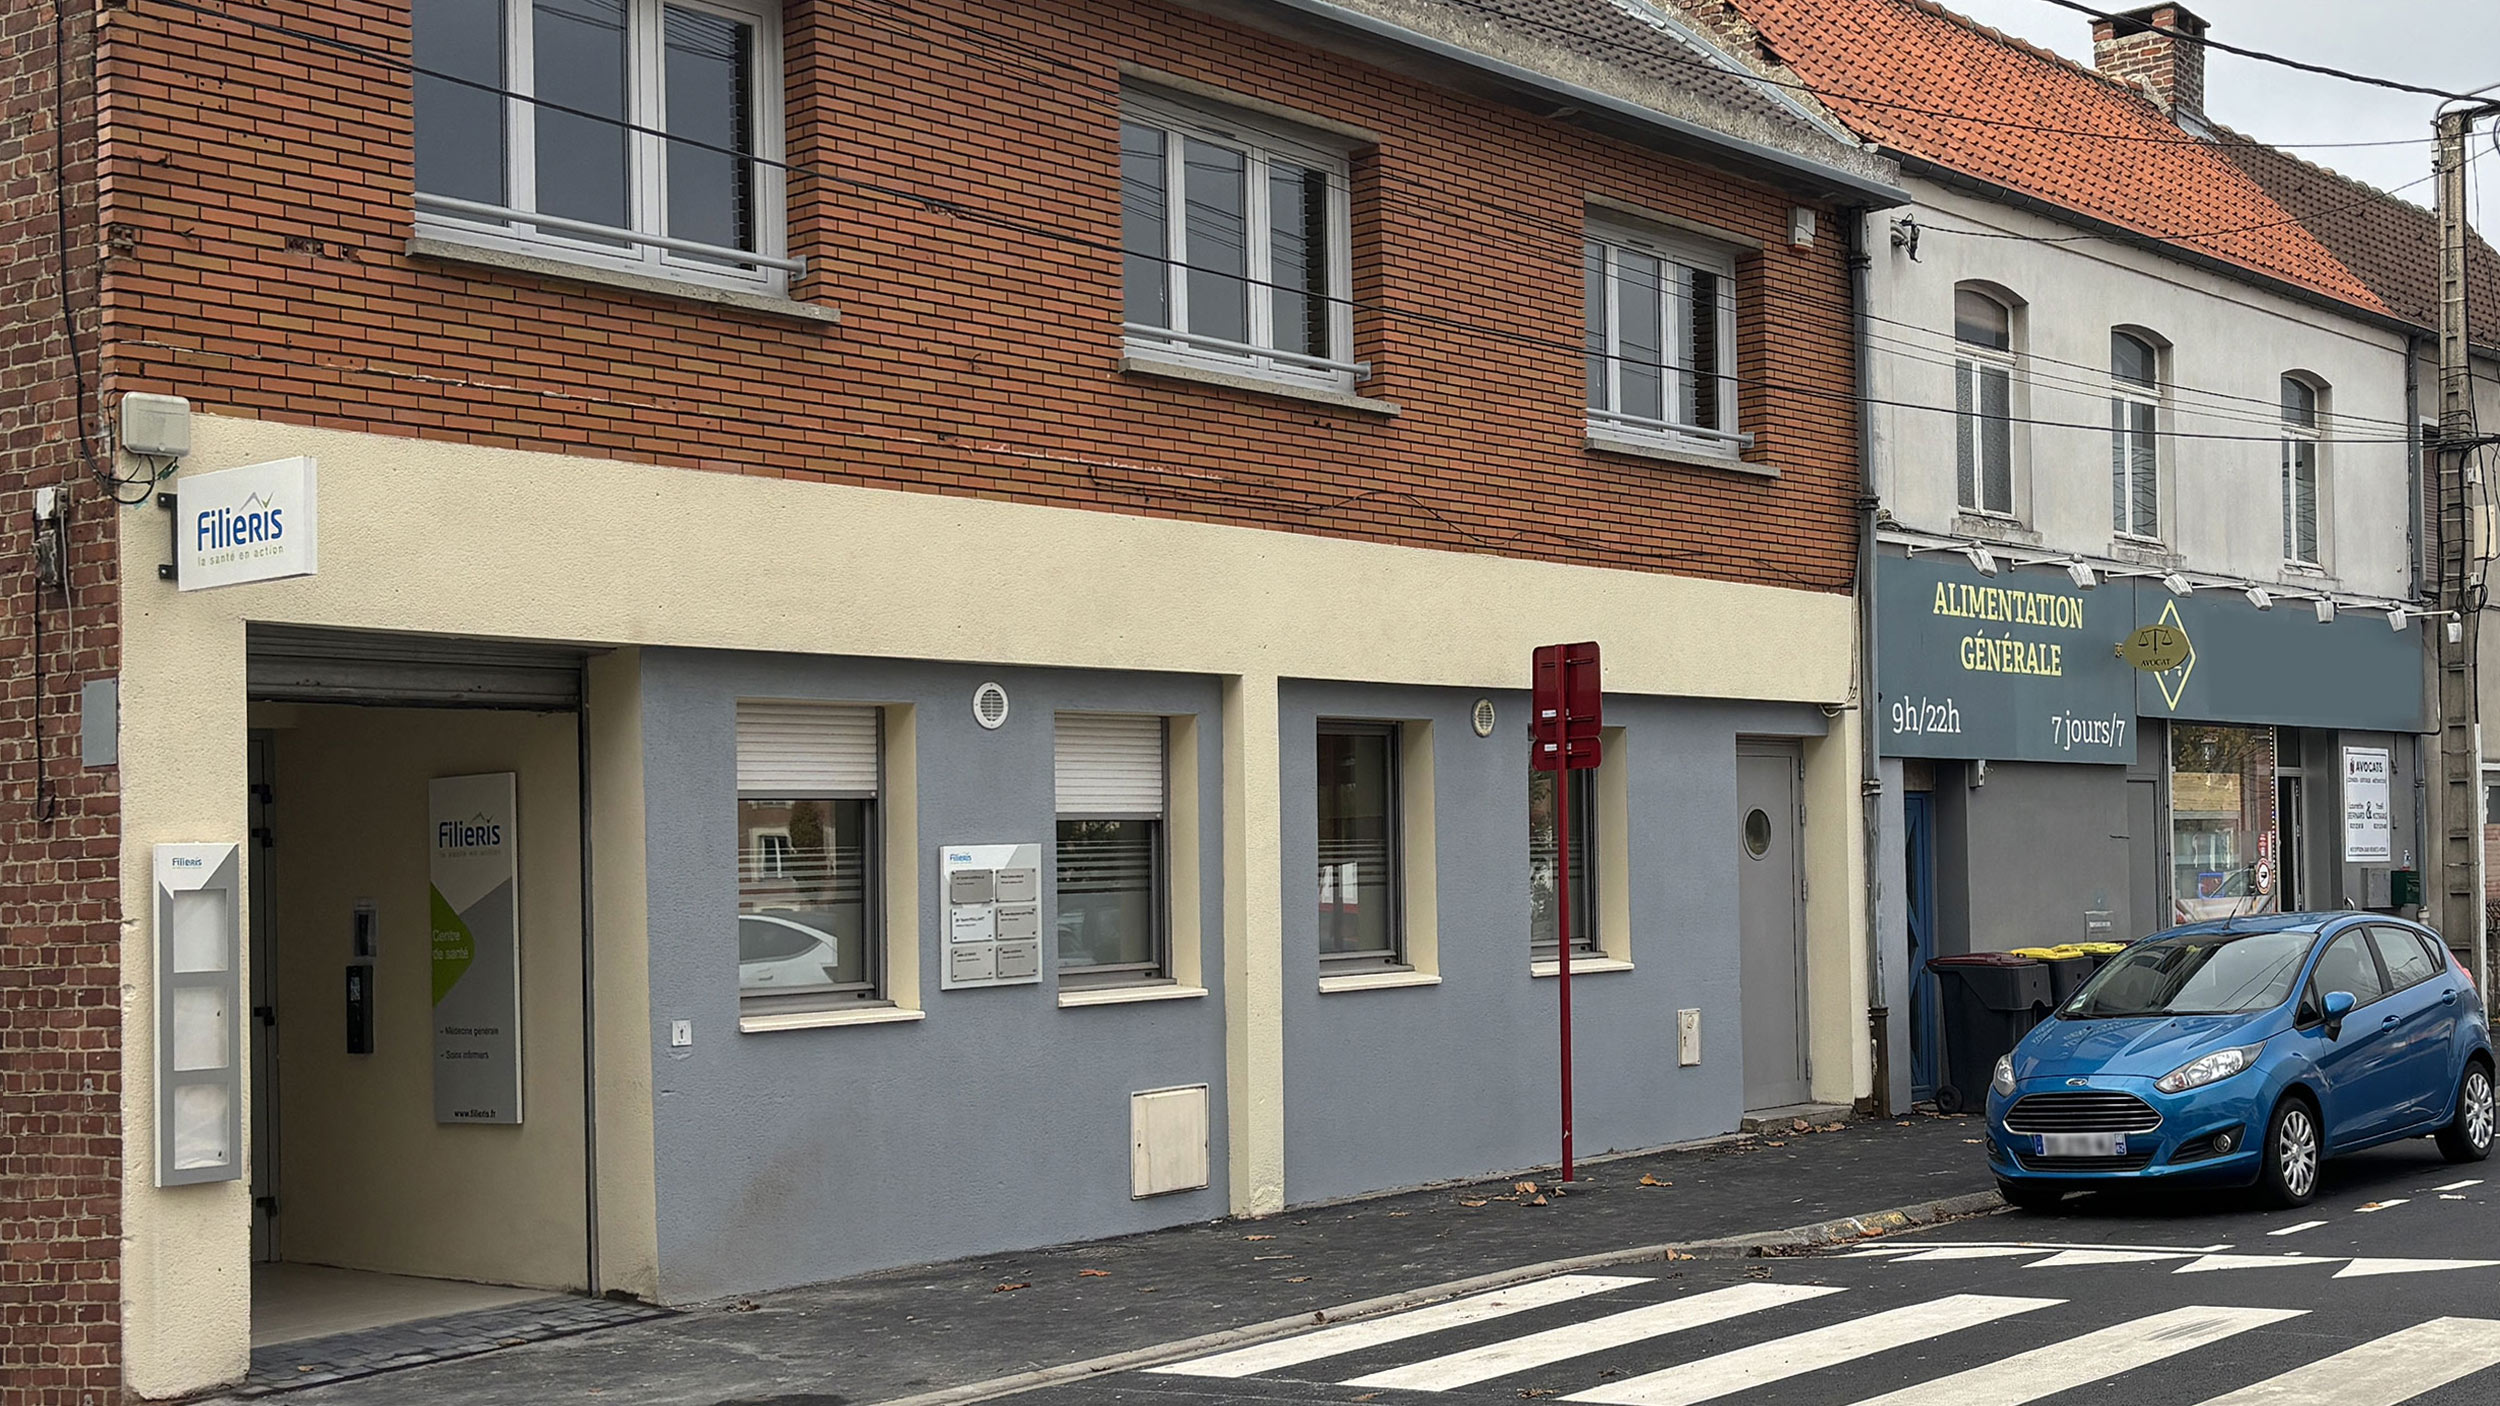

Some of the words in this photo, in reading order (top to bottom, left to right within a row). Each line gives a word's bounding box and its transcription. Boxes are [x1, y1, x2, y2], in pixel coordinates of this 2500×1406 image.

[198, 556, 206, 567] la
[210, 552, 235, 565] santé
[239, 551, 250, 561] en
[254, 545, 283, 557] action
[1933, 581, 2083, 629] ALIMENTATION
[1960, 629, 2063, 677] GÉNÉRALE
[2141, 658, 2172, 668] AVOCAT
[1892, 696, 1961, 736] 9h/22h
[2052, 716, 2062, 745] 7
[2064, 710, 2126, 751] jours/7
[2356, 761, 2383, 772] AVOCATS
[2366, 800, 2373, 819] &
